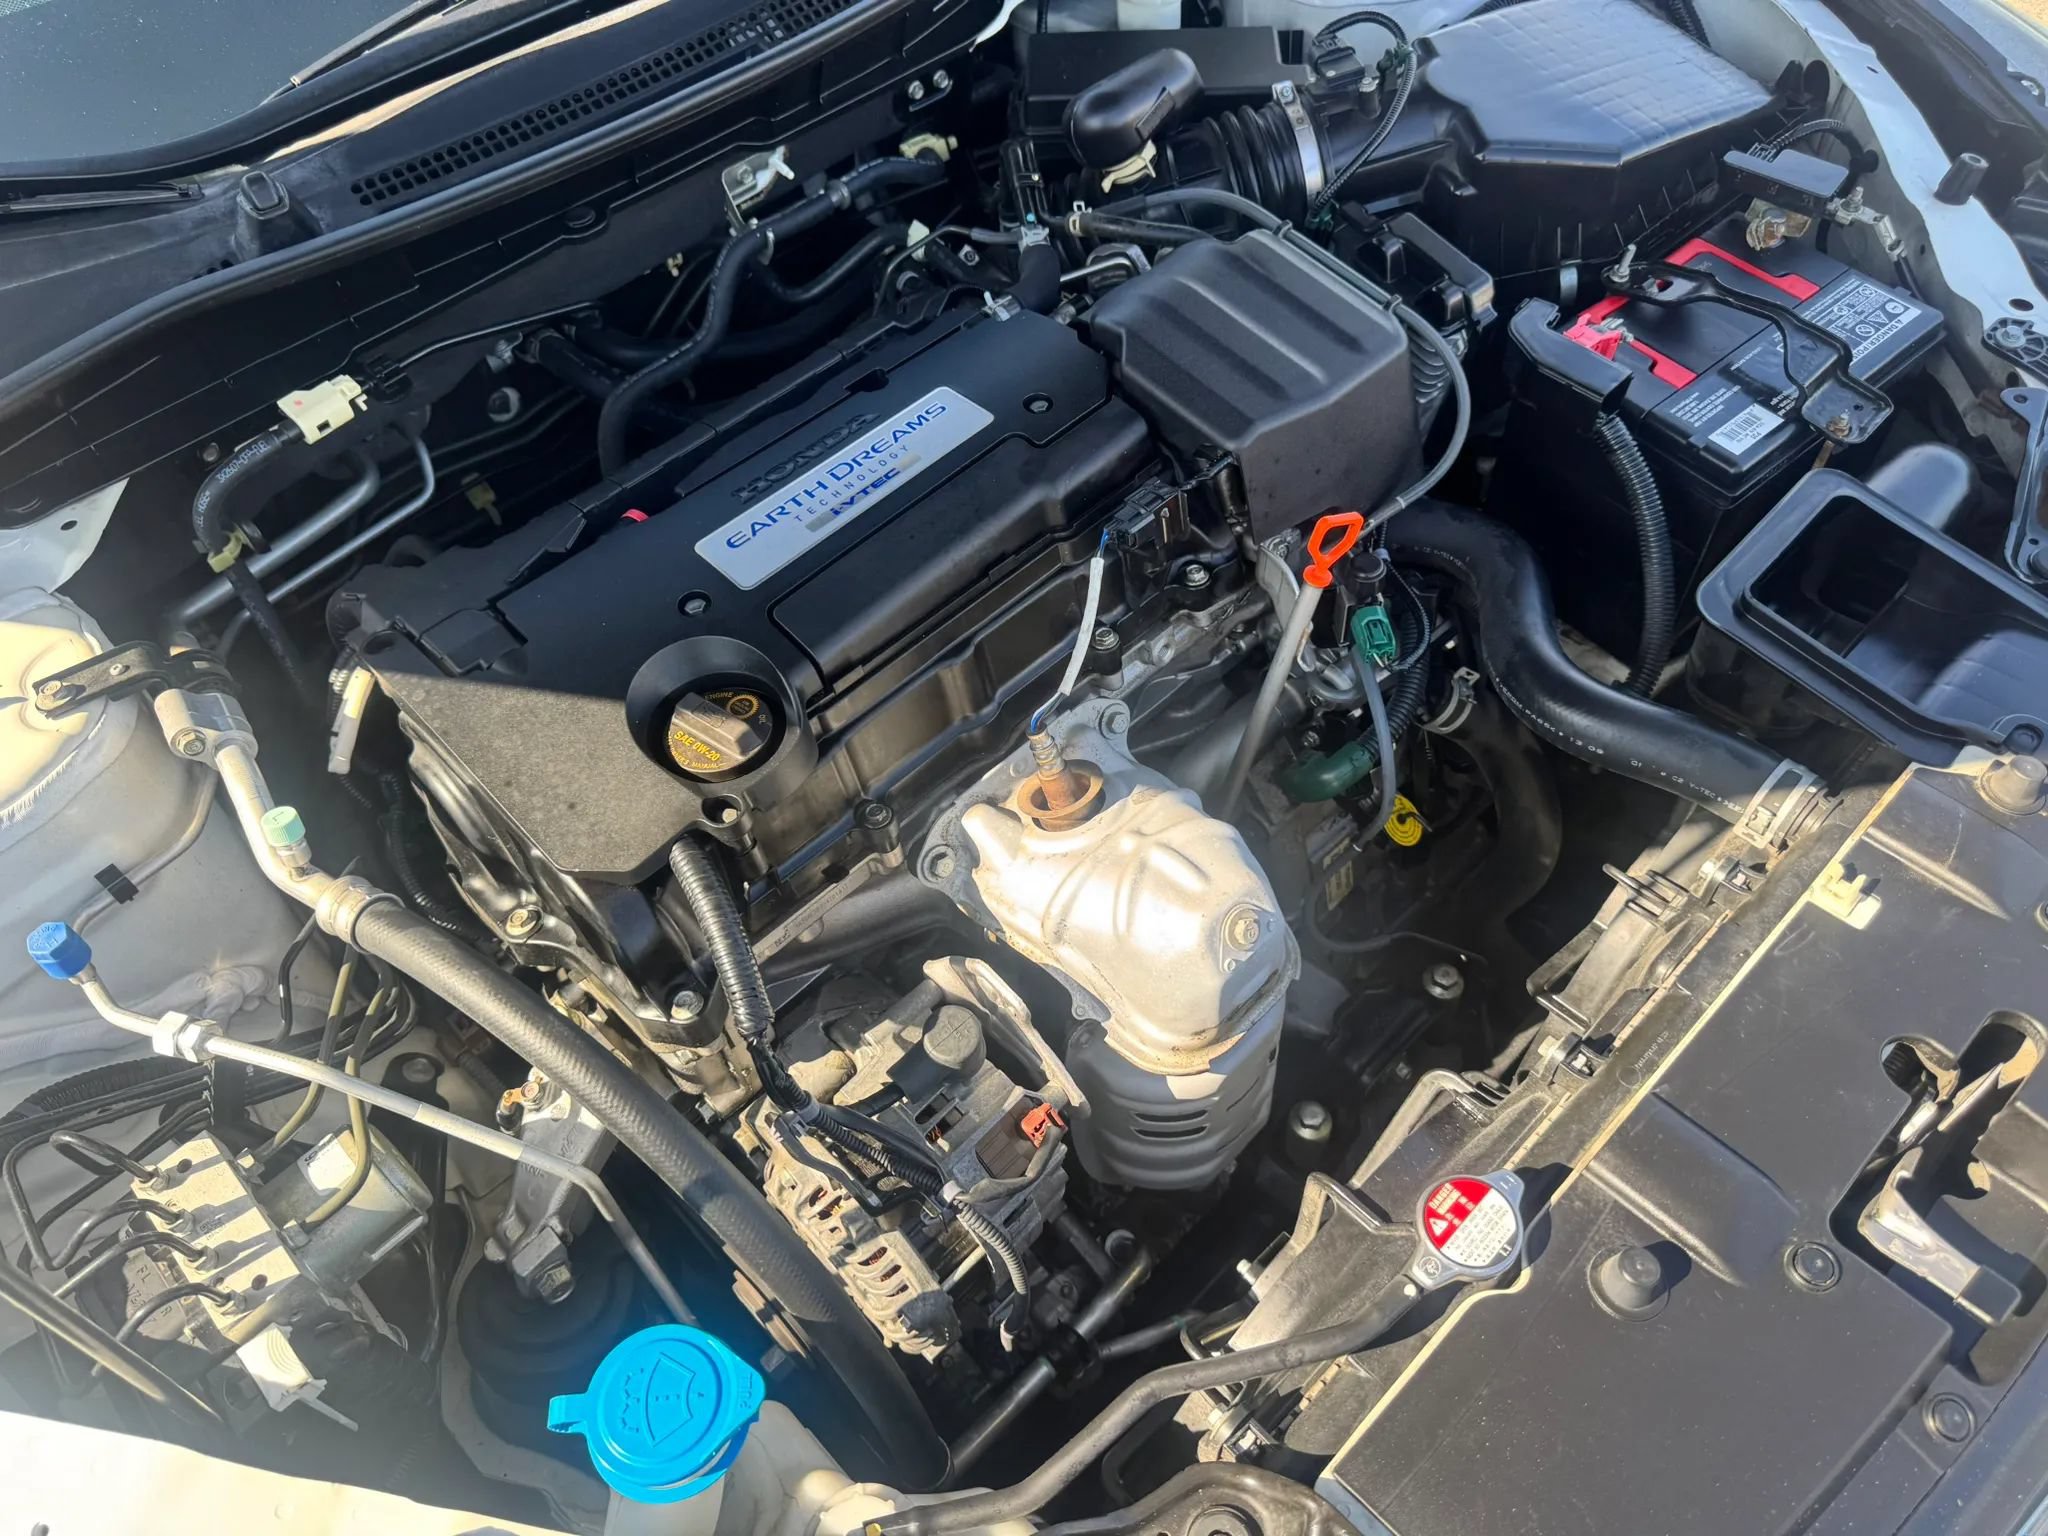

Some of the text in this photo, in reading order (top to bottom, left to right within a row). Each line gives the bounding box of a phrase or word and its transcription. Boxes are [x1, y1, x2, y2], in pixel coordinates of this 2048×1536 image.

[725, 401, 947, 549] EARTH DREAMS
[731, 412, 881, 504] HONDA
[794, 443, 910, 523] TECHNOLOGY
[831, 467, 901, 517] i-VTEC
[704, 691, 735, 700] ENGINE
[674, 730, 696, 747] SAE
[692, 742, 721, 762] 0W-20
